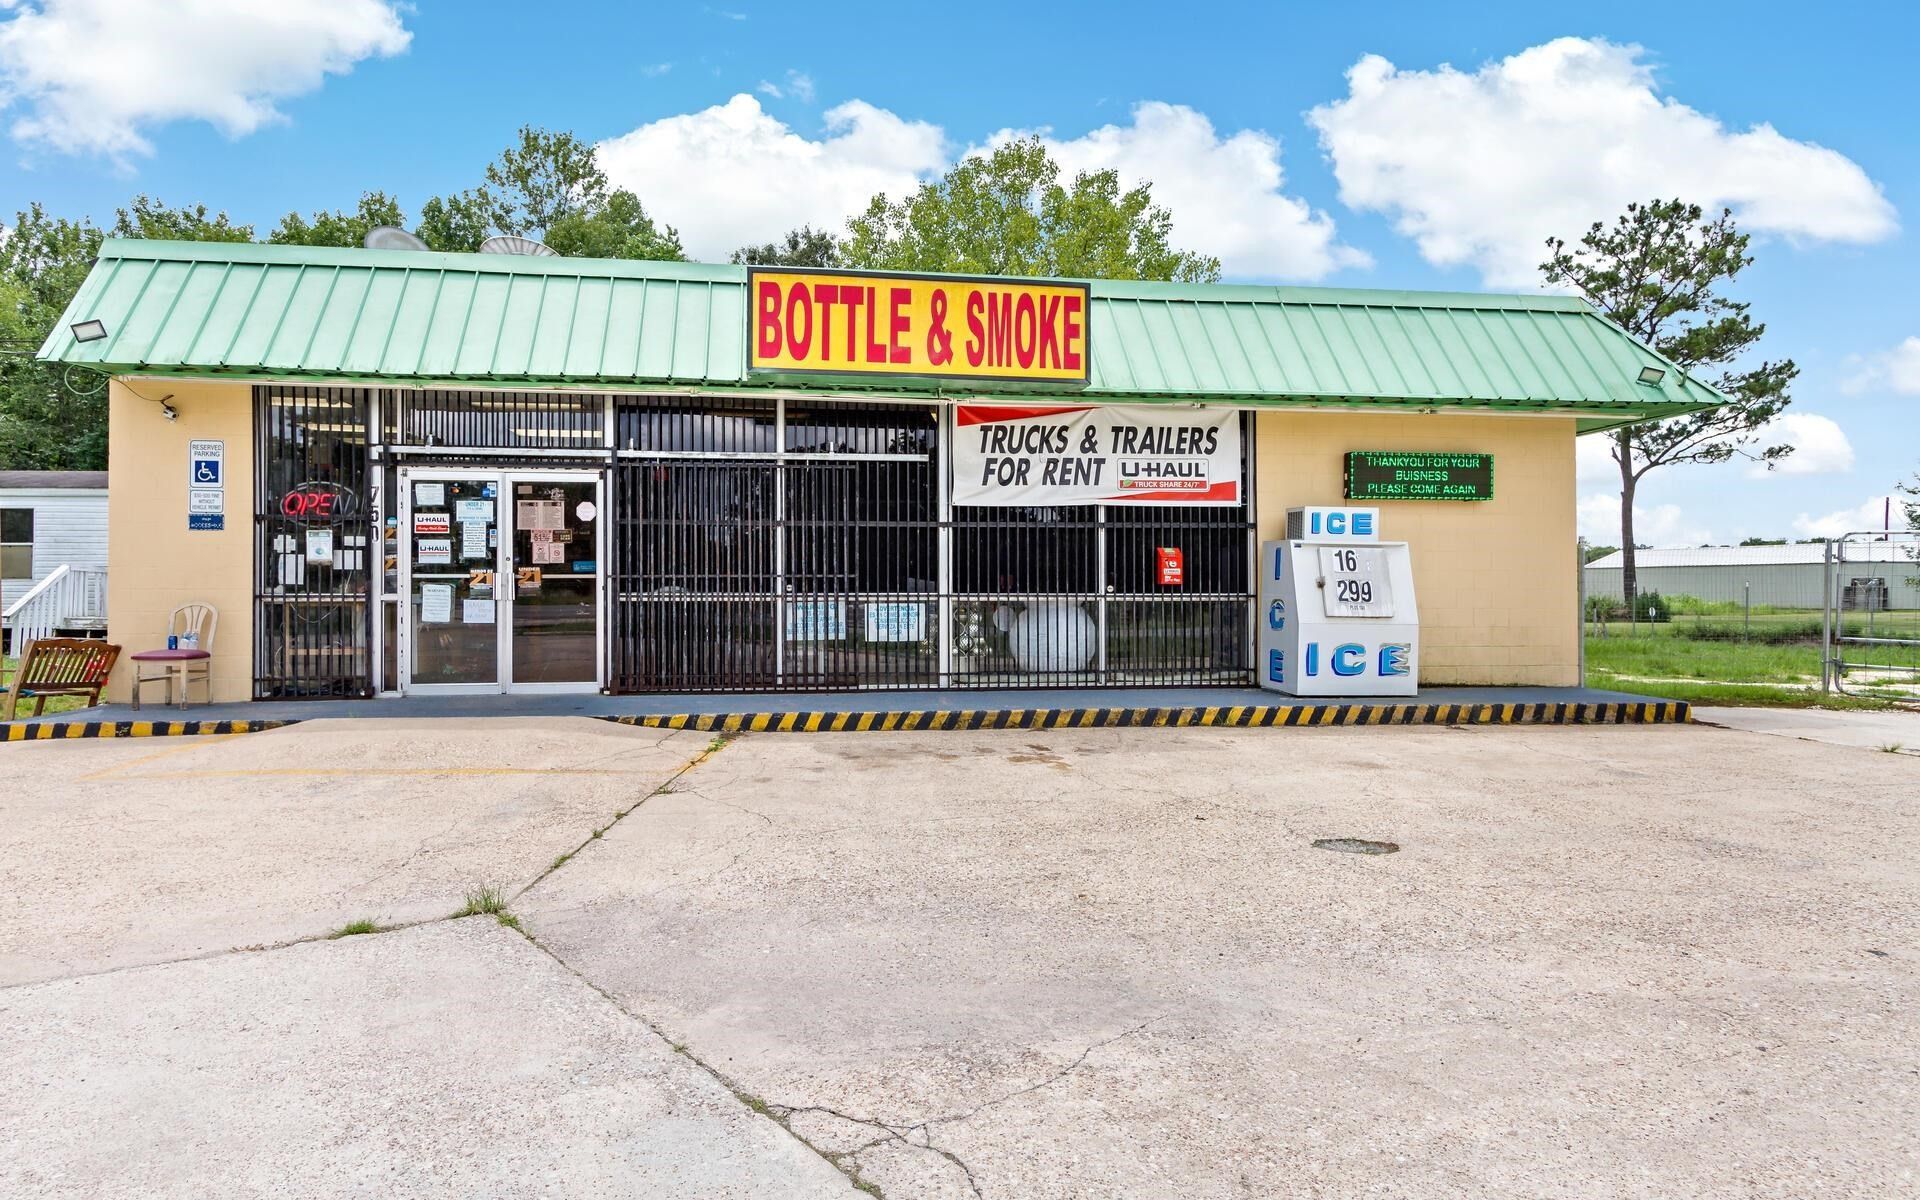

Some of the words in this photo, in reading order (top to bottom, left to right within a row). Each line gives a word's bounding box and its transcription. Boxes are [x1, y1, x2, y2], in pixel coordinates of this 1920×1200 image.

[758, 281, 912, 364] BOTTLE
[927, 288, 953, 366] &
[965, 290, 1081, 370] SMOKE
[979, 424, 1069, 454] TRUCKS
[1079, 424, 1098, 454] &
[1111, 426, 1219, 455] TRAILERS
[981, 457, 1032, 487] FOR
[1042, 457, 1106, 487] RENT
[1121, 462, 1205, 478] U-HAUL
[1366, 456, 1424, 467] THANKYOU
[1427, 457, 1448, 468] FOR
[1451, 457, 1479, 468] YOUR
[1183, 481, 1199, 489] 24/7
[1395, 470, 1448, 481] BUISNESS
[1367, 483, 1408, 494] PLEASE
[1410, 484, 1441, 494] COME
[1443, 484, 1476, 494] AGAIN
[285, 493, 354, 516] OPEN
[1311, 512, 1373, 535] ICE
[1334, 549, 1357, 572] 16
[1337, 580, 1372, 603] 299
[1306, 642, 1411, 677] ICE
